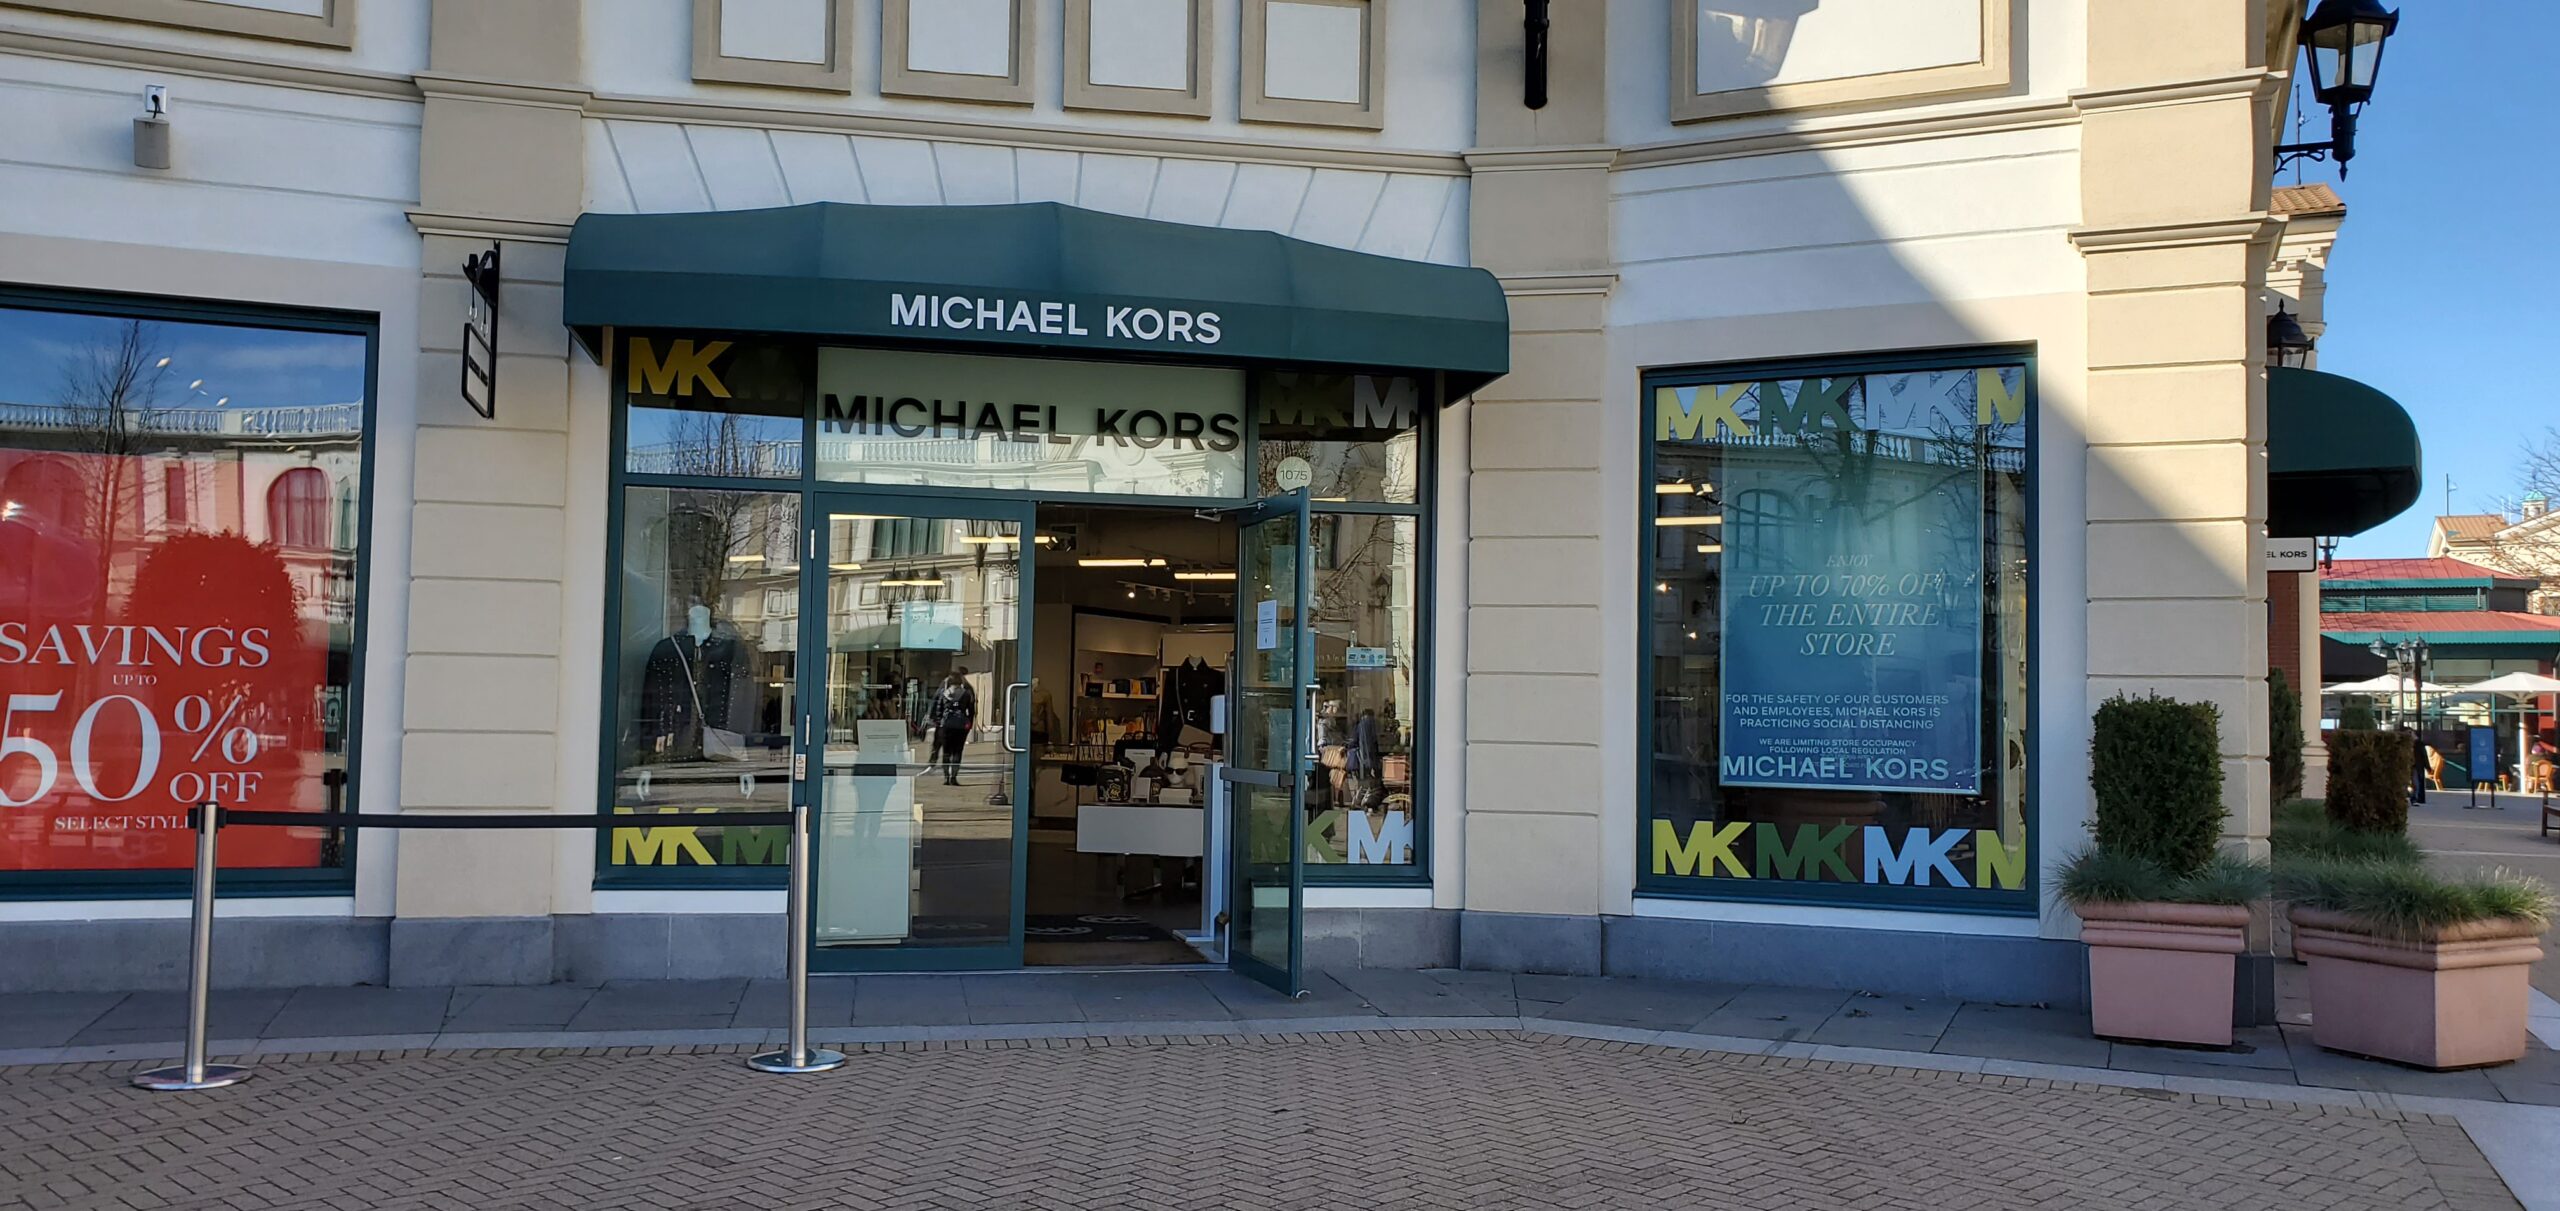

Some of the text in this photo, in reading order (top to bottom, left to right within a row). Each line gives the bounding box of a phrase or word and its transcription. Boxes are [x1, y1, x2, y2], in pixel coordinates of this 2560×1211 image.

[891, 293, 1221, 344] MICHAEL KORS
[628, 337, 735, 398] MK
[1656, 382, 1753, 441] MK
[1759, 376, 1865, 434] MK
[1865, 369, 1974, 431] MK
[824, 393, 1240, 453] MICHAEL KORS
[1280, 469, 1308, 481] 1075
[1826, 554, 1874, 568] ENJOY
[2280, 550, 2307, 558] KORS
[1749, 575, 1785, 597] UP
[1794, 574, 1830, 597] TO
[1840, 574, 1890, 597] 70%
[1760, 603, 1941, 626] THE ENTIRE
[0, 622, 269, 668] SAVINGS
[1800, 633, 1896, 656] STORE
[113, 674, 157, 686] UP TO
[1725, 694, 1949, 705] FOR THE SAFETY OF OUR CUSTOMERS
[1733, 706, 1941, 717] AND EMPLOYEES, MICHAEL KORS IS
[1740, 718, 1934, 729] PRACTICING SOCIAL DISTANCING
[0, 688, 259, 807] 50%
[1759, 738, 1916, 748] WE ARE LIMITING STORE OCCUPANCY
[1769, 746, 1906, 755] FOLLOWING LOCAL REGULATION
[1723, 755, 1949, 780] MICHAEL KORS
[169, 772, 263, 804] OFF
[54, 816, 133, 831] SELECT
[612, 806, 719, 865] MK
[1652, 818, 1752, 878] MK
[1756, 822, 1858, 882] MK
[1864, 825, 1971, 888] MK
